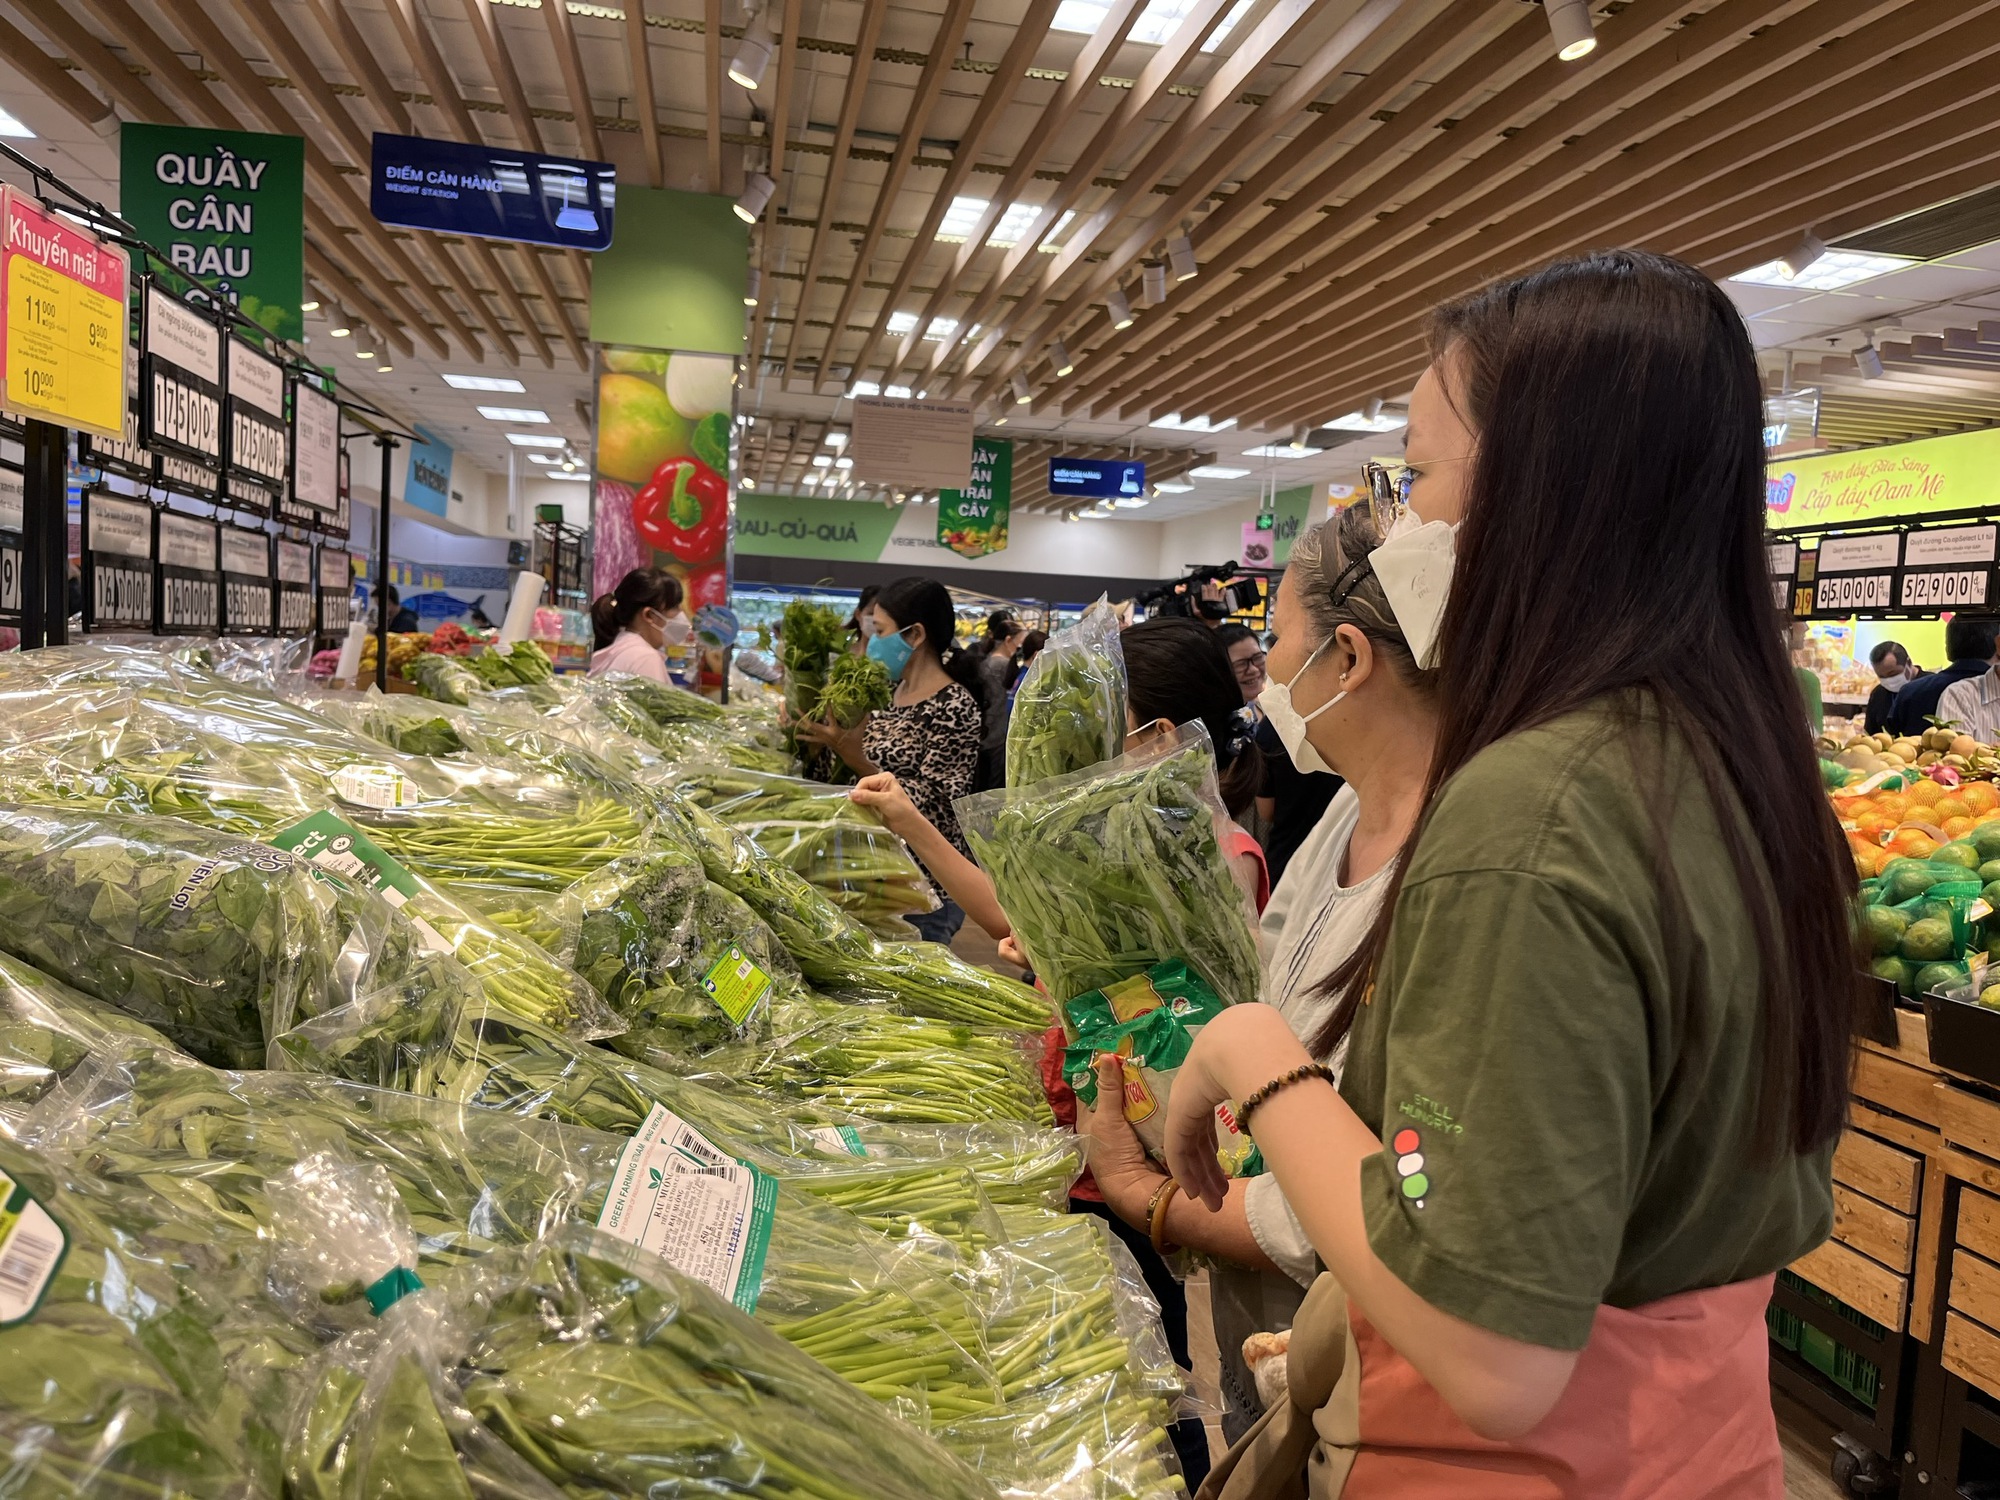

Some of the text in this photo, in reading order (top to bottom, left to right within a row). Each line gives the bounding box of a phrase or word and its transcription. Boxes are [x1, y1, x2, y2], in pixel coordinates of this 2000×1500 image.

[155, 145, 269, 192] QUẦY
[427, 172, 458, 187] CÂN
[461, 175, 503, 193] HÀNG
[168, 193, 252, 234] CÂN
[9, 213, 69, 270] Khuyến
[72, 253, 97, 283] mãi
[169, 243, 251, 278] RAU
[971, 465, 992, 483] ÂN
[1898, 457, 1930, 478] Sáng
[1914, 473, 1945, 501] Mê
[958, 502, 990, 518] CÂY
[1820, 574, 1875, 602] 65.000
[1904, 574, 1968, 598] 52.900
[291, 830, 327, 856] ect
[169, 885, 196, 911] LỢI
[608, 1197, 625, 1228] GREEN
[619, 1161, 638, 1197] FARMING
[653, 1201, 664, 1217] RAU
[667, 1214, 676, 1226] RAU
[698, 1229, 710, 1245] 450
